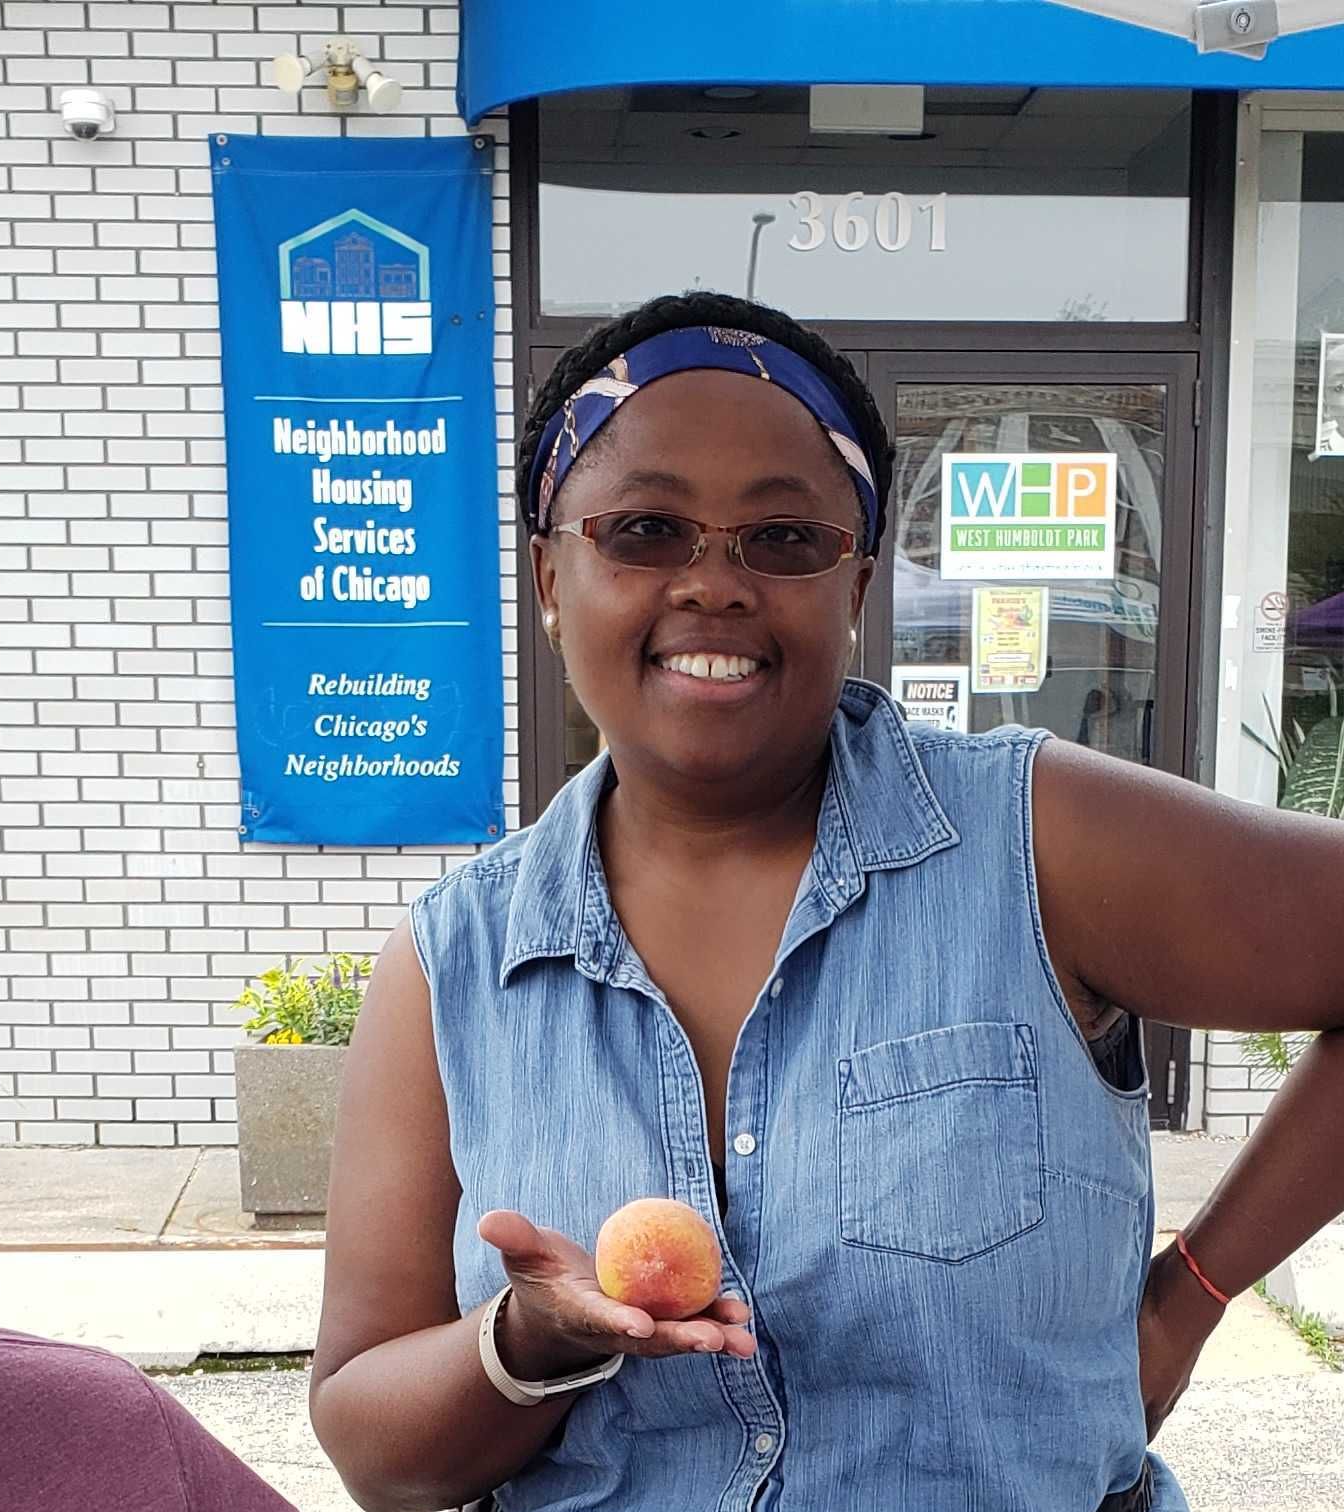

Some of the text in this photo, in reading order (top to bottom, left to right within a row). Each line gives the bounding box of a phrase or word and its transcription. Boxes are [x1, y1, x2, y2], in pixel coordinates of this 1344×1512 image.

[787, 191, 948, 252] 3601
[281, 301, 432, 354] NHS
[273, 417, 446, 462] Neighborhood
[312, 469, 412, 511] Housing
[952, 463, 1106, 517] WHP
[313, 517, 416, 555] Services
[956, 529, 1099, 547] WEST HUMBOLDT PARK
[299, 565, 431, 609] of Chicago
[308, 673, 432, 700] Rebuilding
[907, 683, 954, 699] NOTICE
[314, 714, 428, 742] Chicago's
[904, 707, 921, 716] ACE
[284, 754, 461, 782] Neighborhoods
